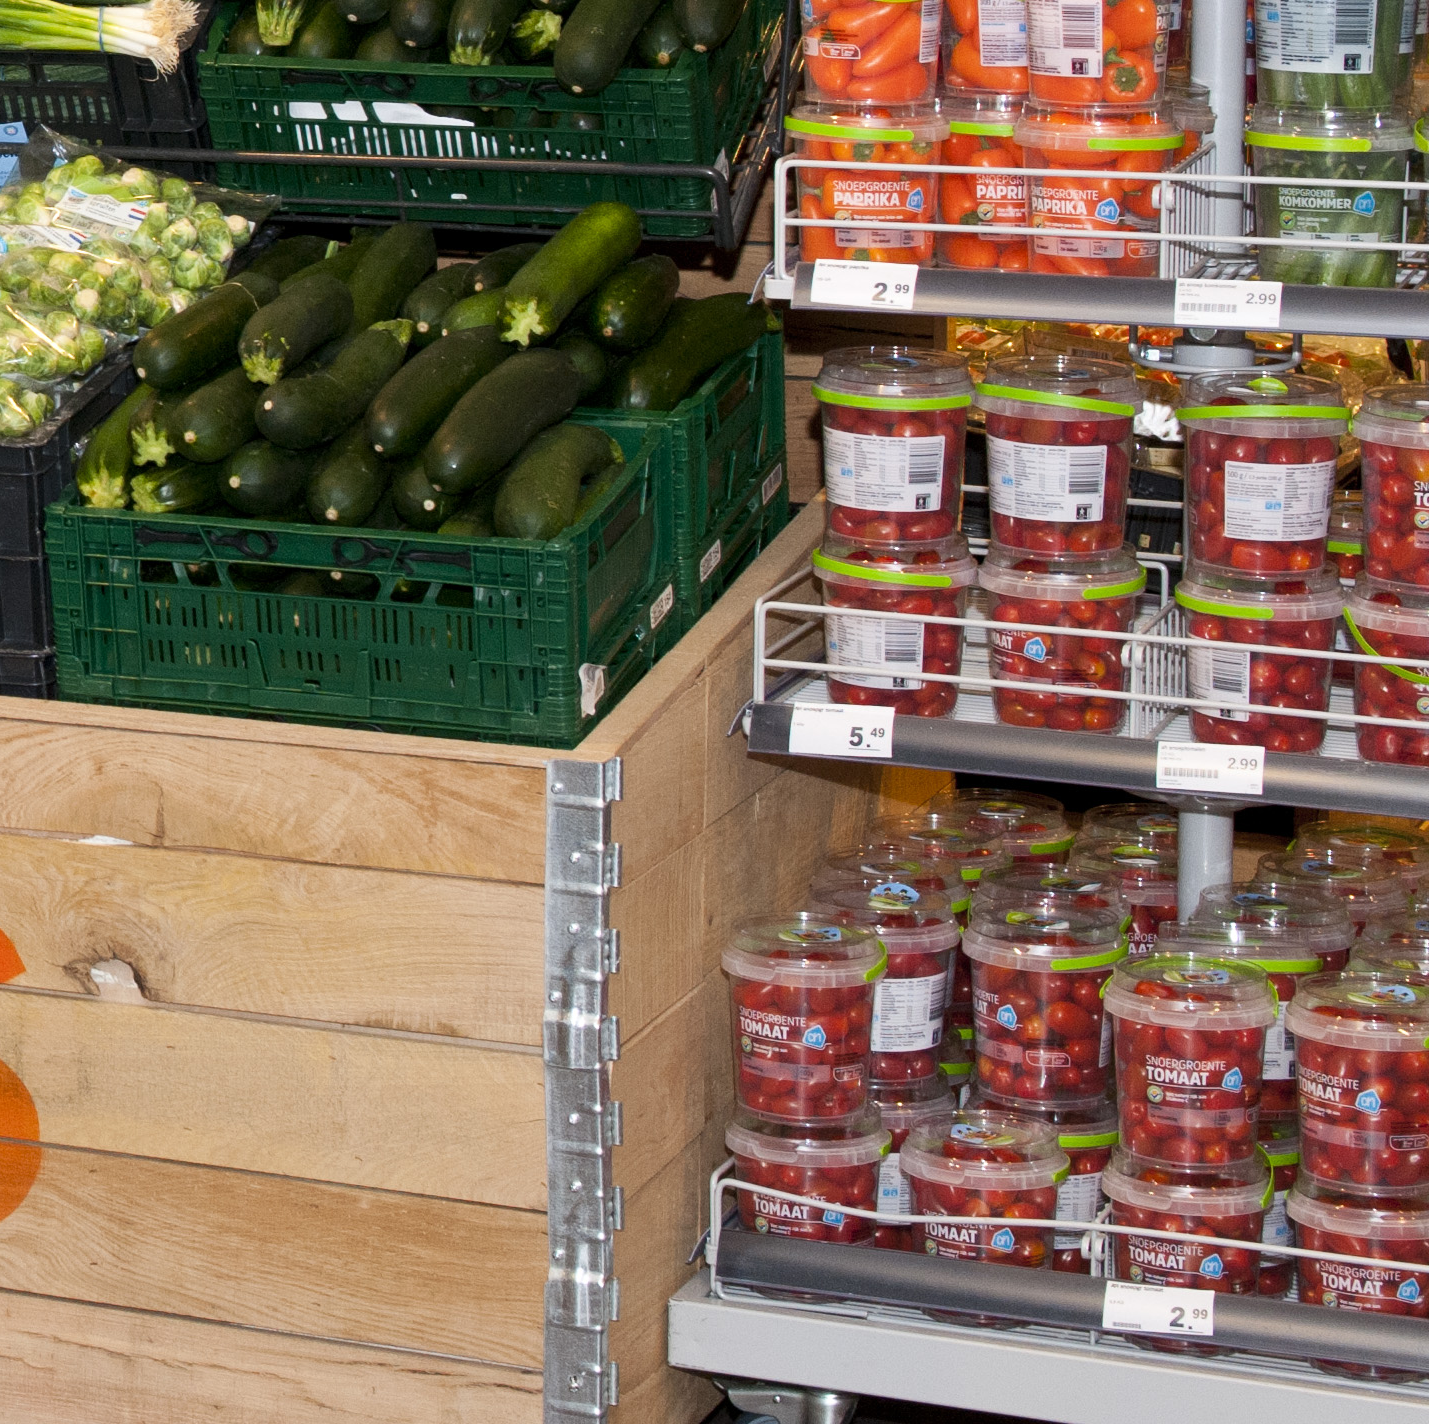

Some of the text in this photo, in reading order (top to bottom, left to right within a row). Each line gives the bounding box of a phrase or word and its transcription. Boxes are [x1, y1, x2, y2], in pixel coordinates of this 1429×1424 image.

[833, 180, 911, 191] SNOEPGROENTE
[1279, 187, 1336, 197] SNOEPGROENTE
[833, 192, 900, 206] PAPRIKA
[1032, 197, 1087, 215] PAPRIKA
[1279, 196, 1352, 209] KOMKOMMER
[871, 282, 910, 304] 2.99
[1245, 292, 1277, 305] 2.99
[849, 726, 885, 748] 5.49
[1227, 757, 1258, 770] 2.99
[739, 1005, 807, 1027] SNOEPGROENTE
[740, 1017, 789, 1039] TOMAAT
[1146, 1066, 1209, 1086] TOMAAT
[1298, 1075, 1341, 1102] TOMAAT
[754, 1197, 809, 1220] TOMAAT
[924, 1221, 977, 1244] TOMAAT
[1128, 1234, 1204, 1257] SNOEPGROENTE
[1128, 1245, 1185, 1270] TOMAAT
[1320, 1260, 1401, 1282] SNOEPGROENTE
[1320, 1271, 1384, 1296] TOMAAT
[1169, 1306, 1208, 1330] 2.99
